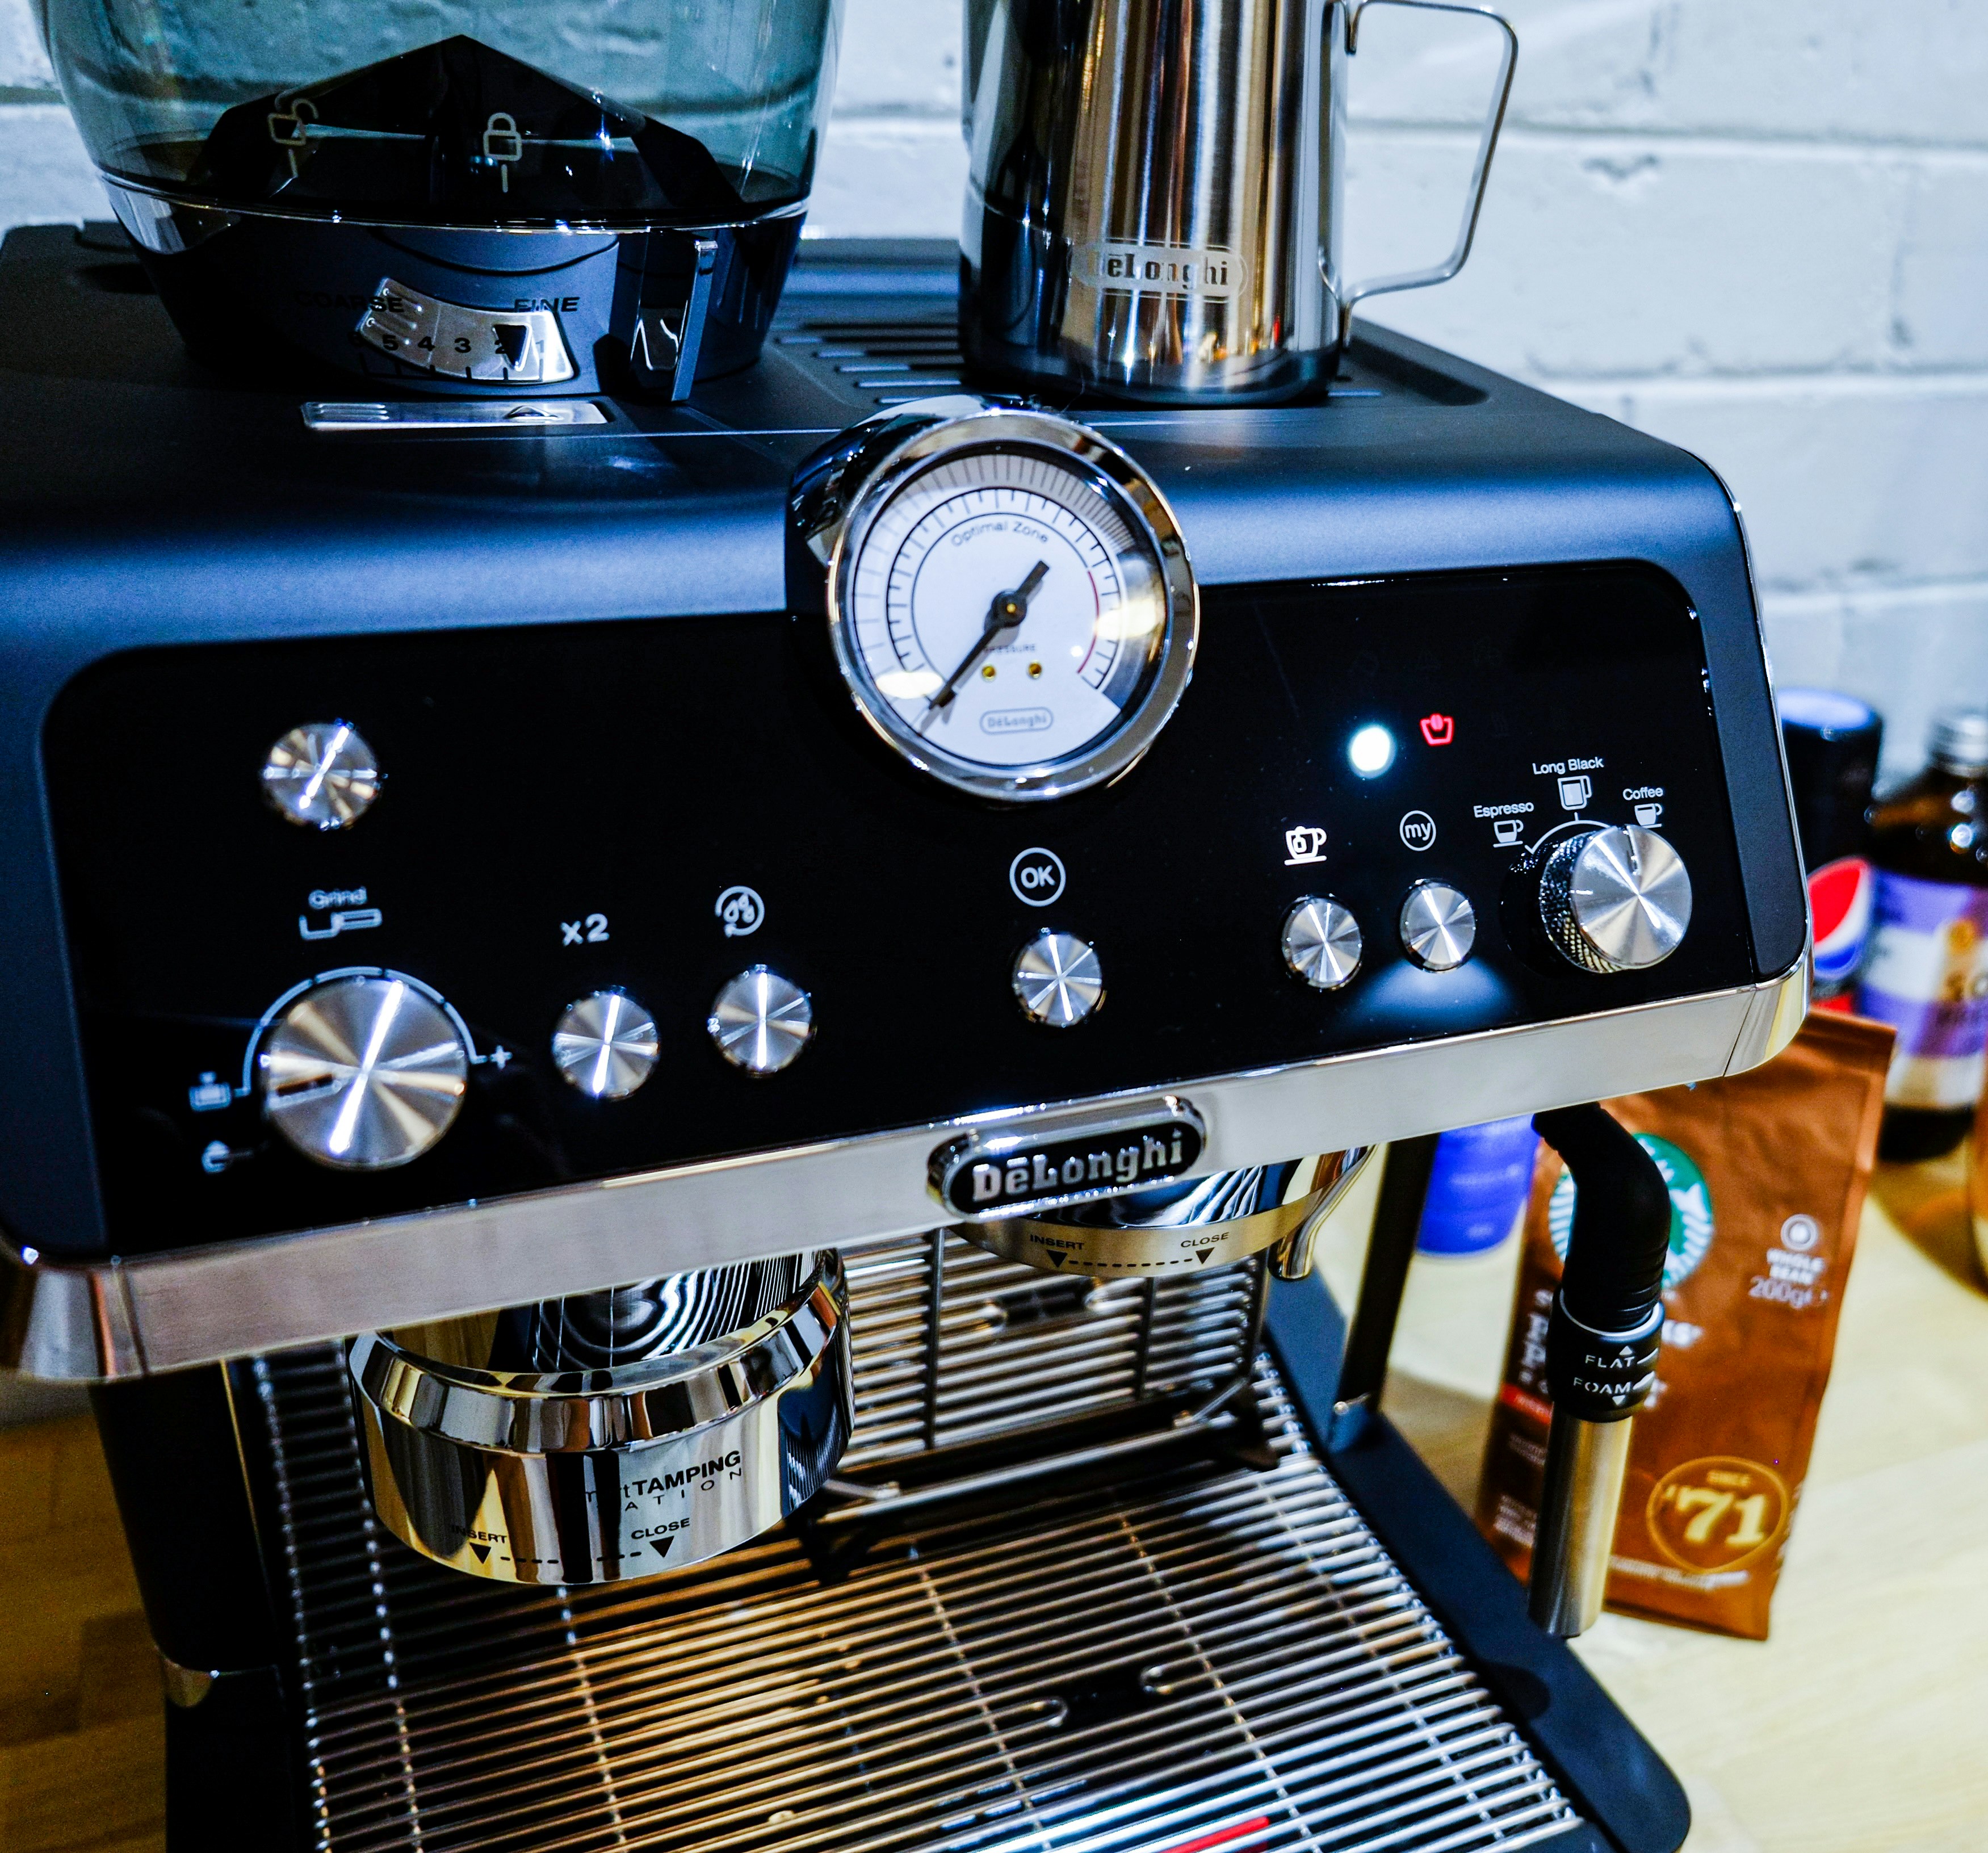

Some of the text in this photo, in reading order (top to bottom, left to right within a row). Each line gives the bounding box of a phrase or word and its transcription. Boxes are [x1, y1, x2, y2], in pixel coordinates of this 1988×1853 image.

[295, 291, 405, 313] COARSE
[514, 296, 580, 312] FINE
[383, 335, 397, 351] 5
[417, 336, 435, 351] 4
[454, 337, 471, 353] 3
[951, 519, 1048, 546] Optimal Zone
[1532, 756, 1605, 775] Long Black
[1622, 786, 1664, 801] Coffee
[1473, 802, 1534, 819] Espresso
[1404, 823, 1431, 841] my
[1021, 865, 1056, 889] OK
[308, 886, 367, 909] Grind
[1030, 1234, 1085, 1250] INSERT
[1180, 1231, 1230, 1248] CLOSE
[1584, 1355, 1635, 1369] FLAT
[1573, 1377, 1631, 1394] FOAM
[452, 1525, 508, 1544] INSERT
[631, 1517, 690, 1540] CLOSE
